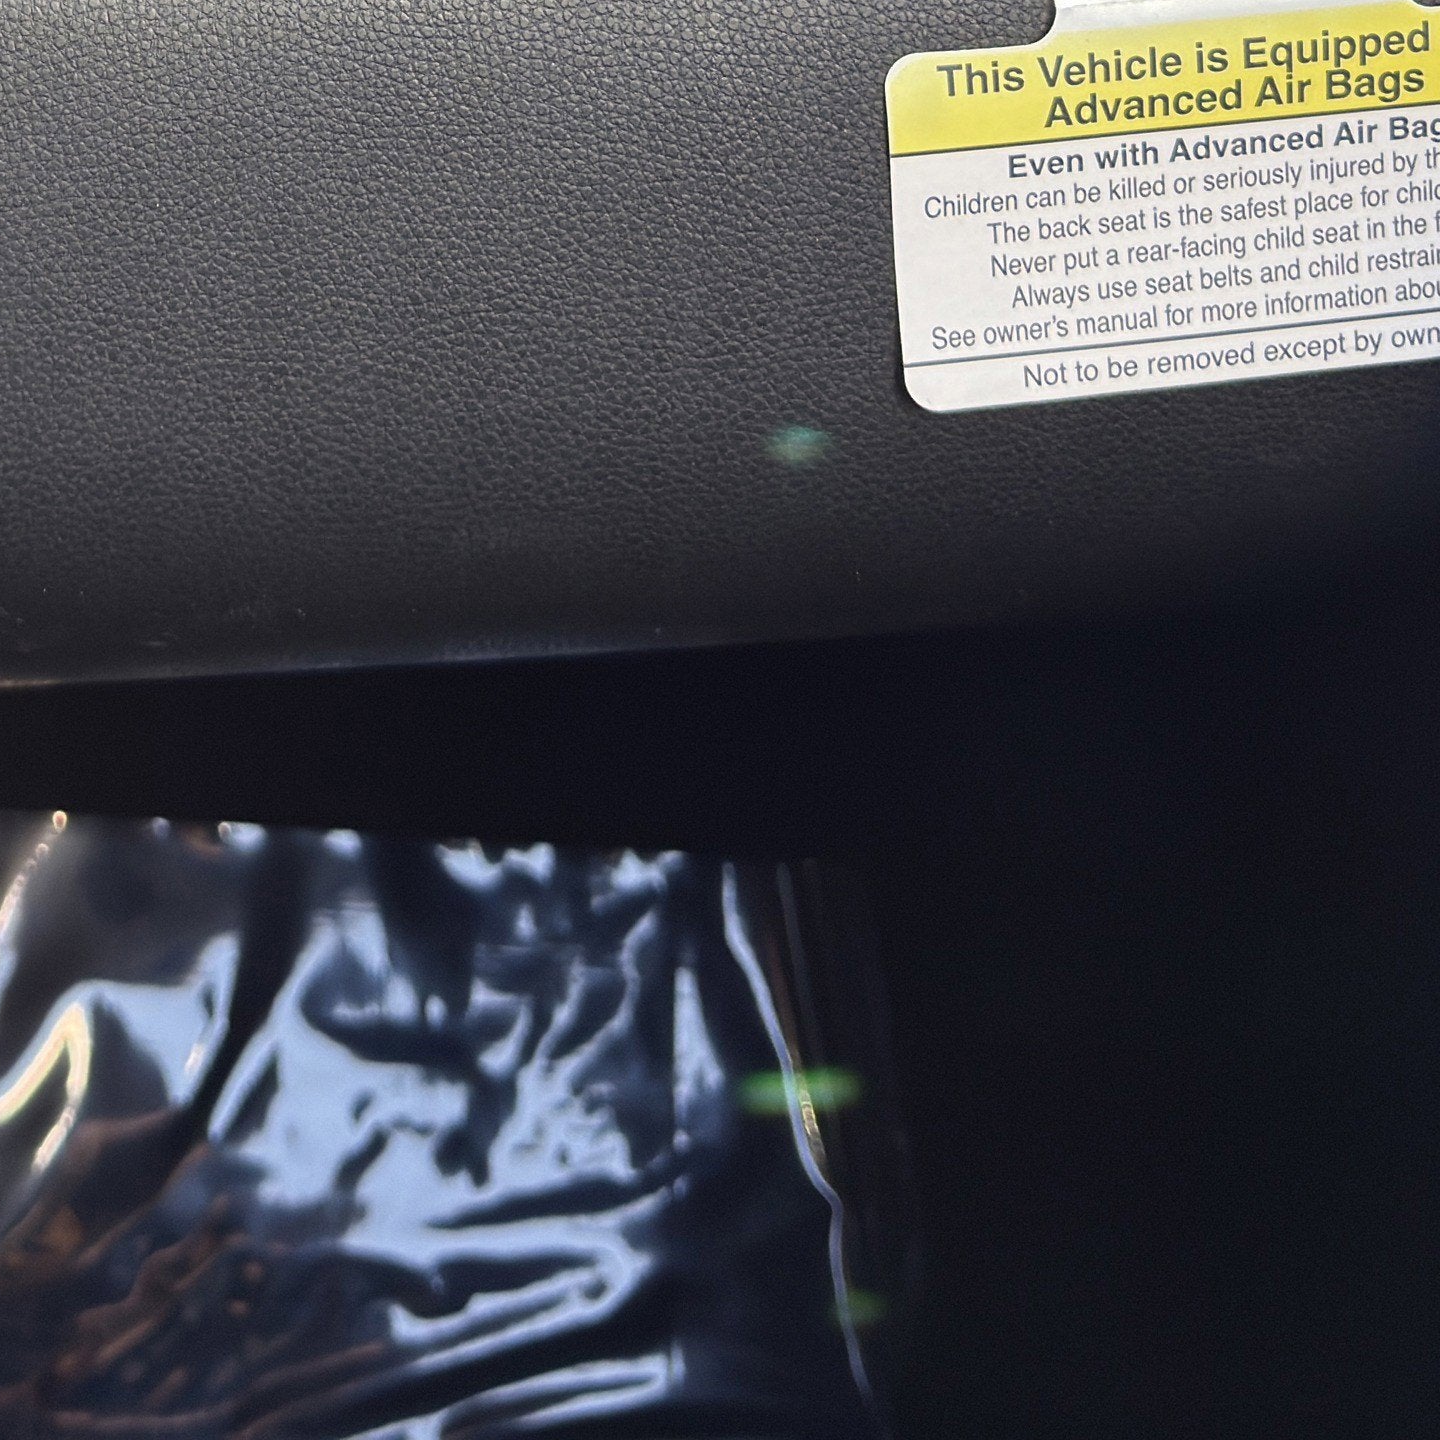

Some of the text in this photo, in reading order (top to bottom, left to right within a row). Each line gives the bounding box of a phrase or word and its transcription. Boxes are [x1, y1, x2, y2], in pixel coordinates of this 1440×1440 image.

[936, 60, 1025, 97] This
[1037, 46, 1182, 88] Vehicle
[1195, 41, 1229, 74] is
[1243, 20, 1430, 72] Equipped
[1044, 68, 1426, 128] Advanced Air Bags
[1008, 152, 1084, 179] Even
[1094, 141, 1159, 170] with
[1169, 124, 1324, 163] Advanced
[1333, 119, 1379, 147] Air
[924, 193, 1018, 219] Children
[1025, 188, 1066, 210] can
[1073, 182, 1101, 205] be
[1108, 174, 1166, 201] killed
[1173, 177, 1196, 195] or
[1203, 161, 1303, 191] seriously
[1309, 153, 1385, 184] injured
[1392, 151, 1418, 178] by
[987, 222, 1031, 245] The
[1039, 214, 1092, 240] back
[1098, 209, 1146, 234] seat
[1153, 206, 1172, 229] is
[1178, 203, 1213, 226] the
[1220, 195, 1287, 222] safest
[1294, 189, 1353, 220] place
[1360, 186, 1390, 209] for
[990, 253, 1056, 277] Never
[1063, 246, 1099, 275] put
[1105, 248, 1120, 266] a
[1128, 233, 1247, 263] rear-facing
[1253, 225, 1305, 251] child
[1312, 222, 1361, 245] seat
[1366, 218, 1387, 239] in
[1393, 213, 1428, 237] the
[1011, 284, 1090, 309] Always
[1098, 278, 1138, 300] use
[1145, 271, 1193, 296] seat
[1200, 264, 1253, 290] belts
[1260, 259, 1301, 284] and
[1308, 251, 1360, 279] child
[931, 326, 976, 350] See
[1076, 305, 1158, 335] manual
[1164, 303, 1194, 326] for
[1201, 297, 1257, 322] more
[1265, 284, 1388, 316] information
[1023, 363, 1068, 388] Not
[1075, 360, 1099, 383] to
[1107, 355, 1138, 379] be
[1147, 340, 1256, 375] removed
[1263, 333, 1346, 361] except
[1354, 328, 1383, 356] by
